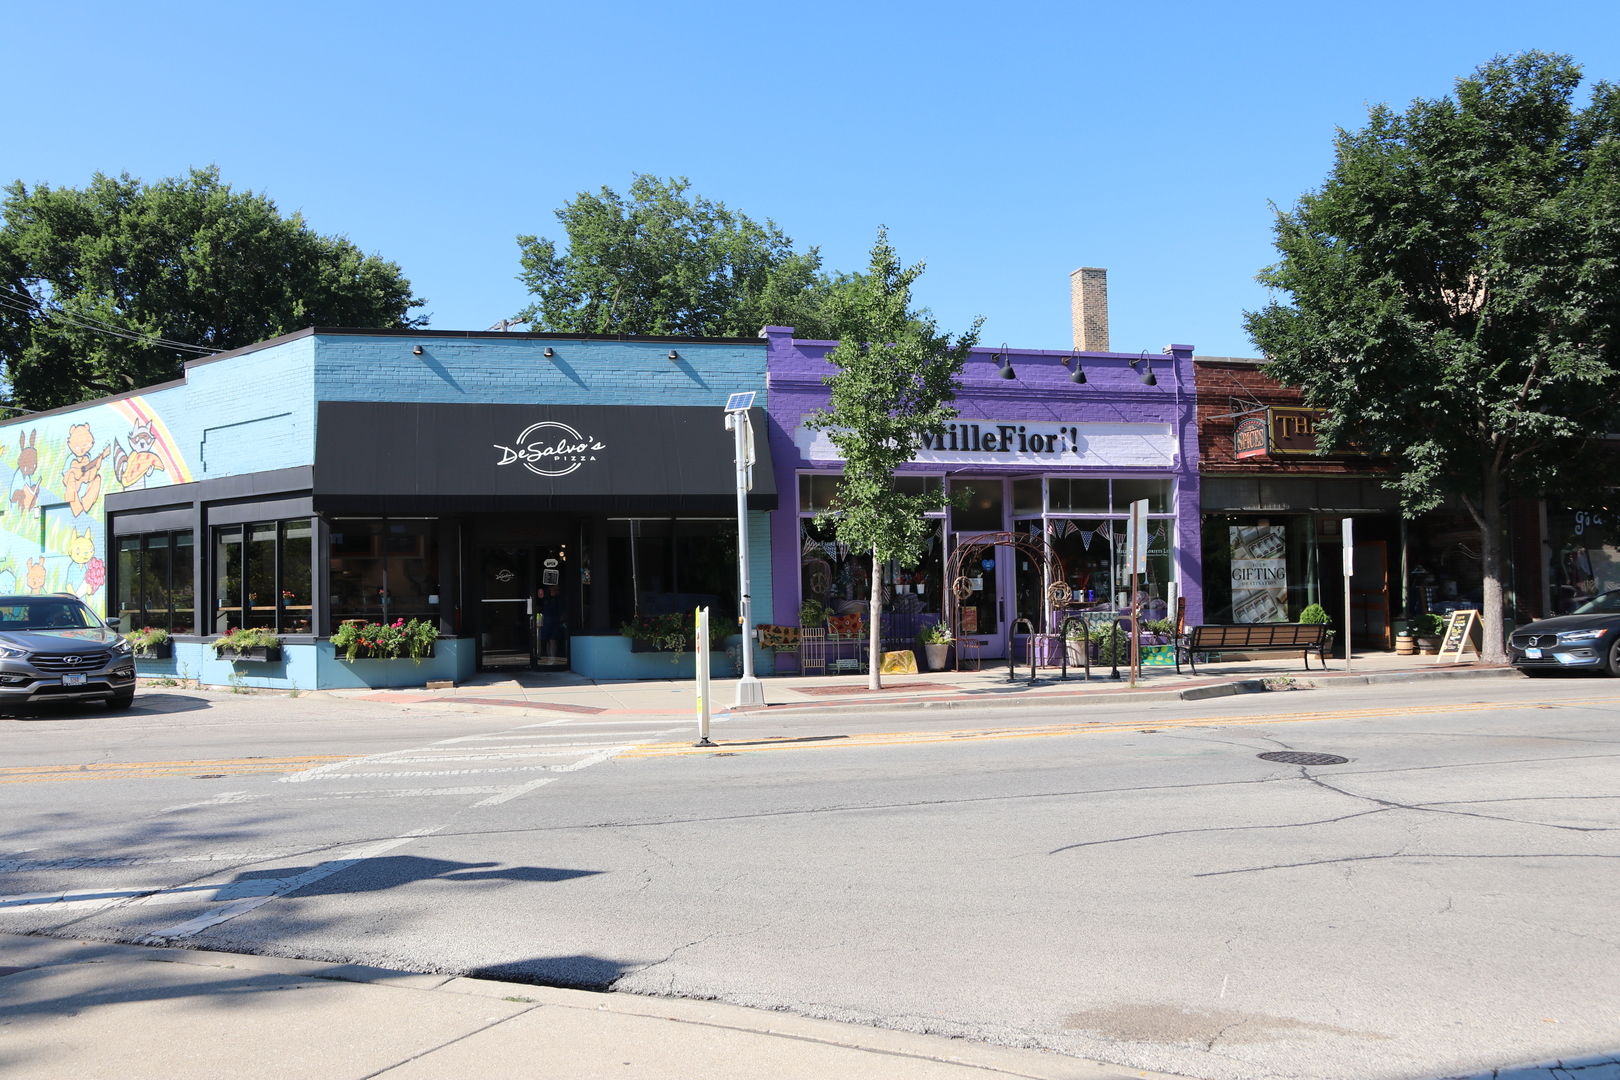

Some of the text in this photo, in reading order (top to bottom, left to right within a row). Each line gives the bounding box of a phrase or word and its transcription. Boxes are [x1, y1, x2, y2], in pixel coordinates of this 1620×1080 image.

[493, 436, 606, 465] DeSalvo's
[1237, 429, 1264, 451] SPICES
[1231, 567, 1285, 581] GIFTING
